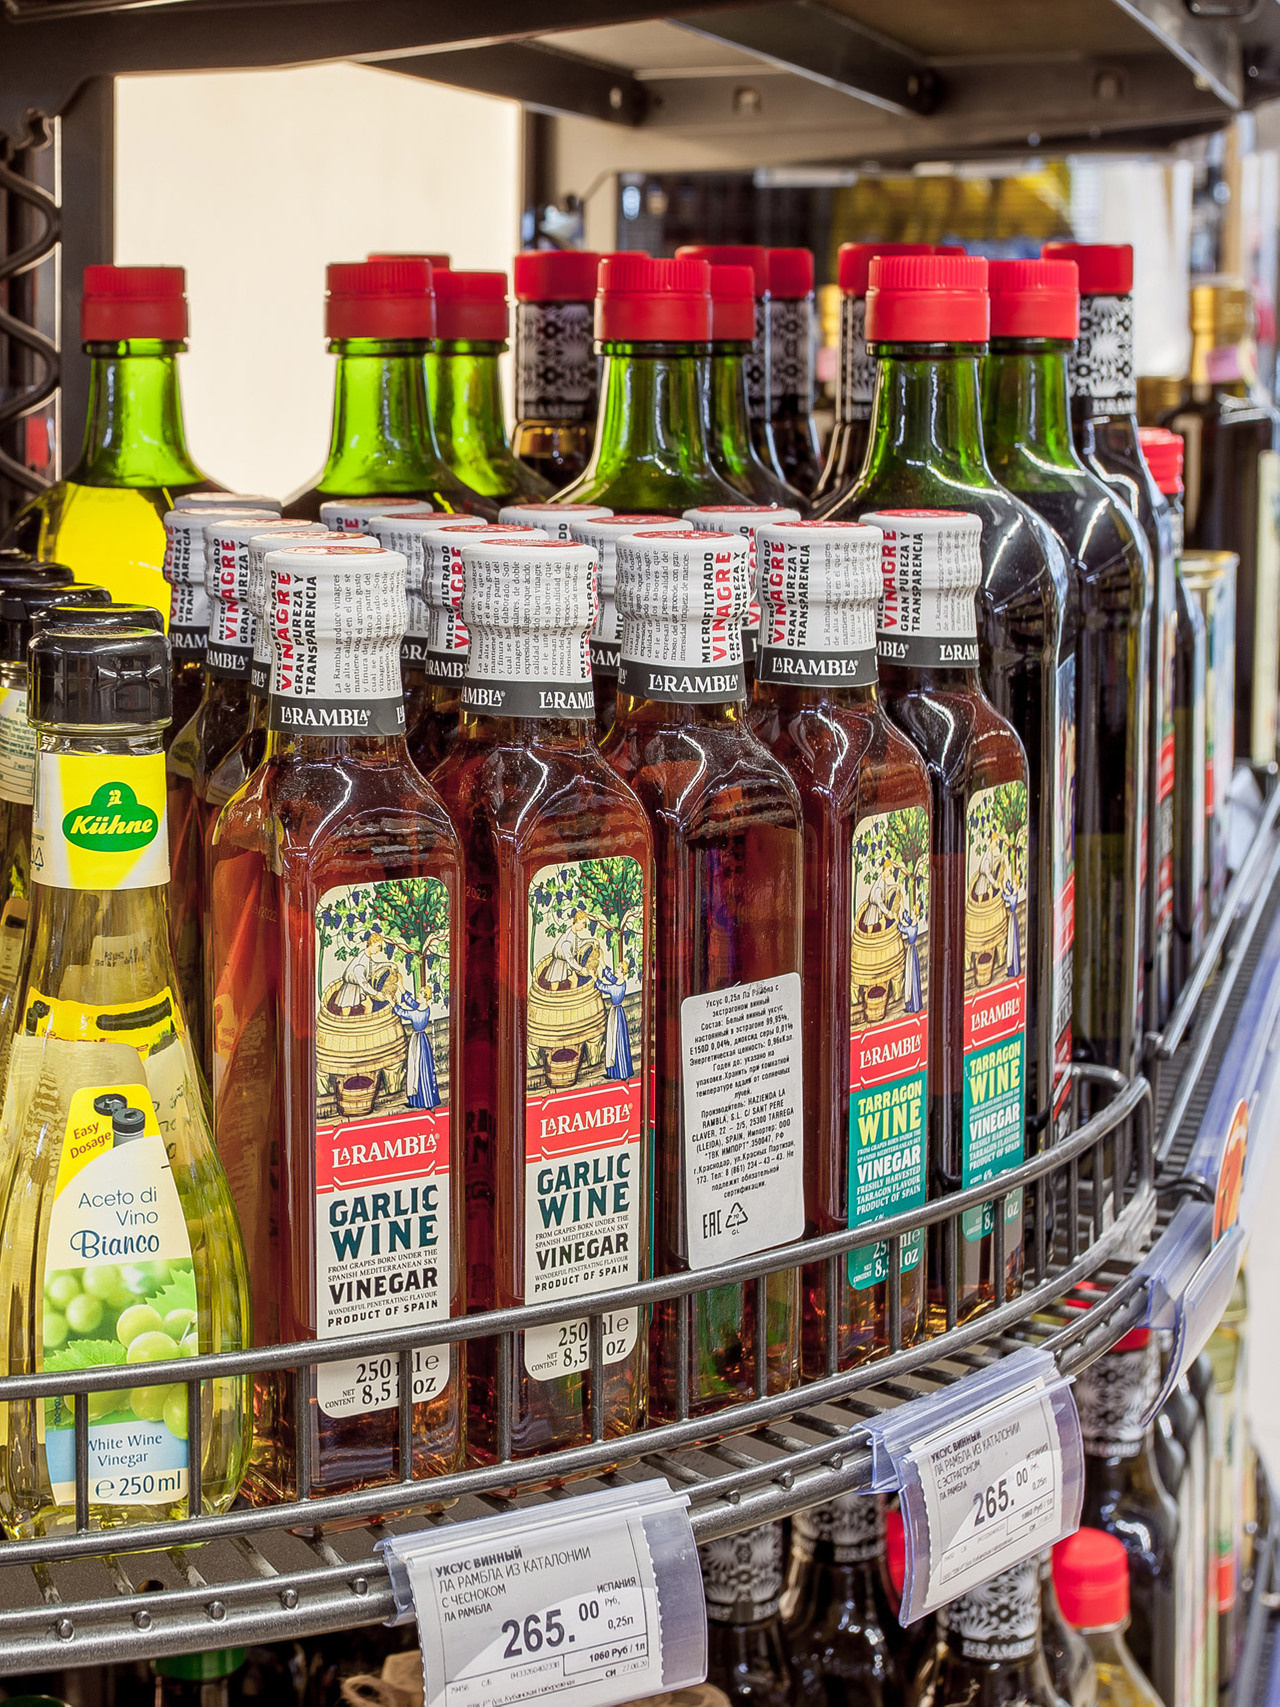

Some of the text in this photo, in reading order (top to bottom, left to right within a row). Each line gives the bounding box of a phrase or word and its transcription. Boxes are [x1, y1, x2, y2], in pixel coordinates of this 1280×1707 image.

[221, 539, 238, 640] VINAGRE
[333, 574, 342, 610] vinagres
[770, 541, 785, 644] VINAGRE
[881, 529, 897, 629] VINAGRE
[911, 533, 923, 632] TRANSPARENCIA
[702, 552, 714, 663] MICROFILTRADO
[713, 551, 731, 662] VINAGRE
[796, 544, 810, 647] TRANSPARENCIA
[276, 573, 294, 691] VINAGRE
[305, 576, 317, 695] TRANSPARENCIA
[69, 814, 153, 835] Kühne
[706, 999, 723, 1008] Уксус
[970, 1040, 1021, 1075] TARRAGON
[970, 1058, 1020, 1105] WINE
[858, 1080, 922, 1116] TARRAGON
[73, 1121, 100, 1140] Easy
[858, 1098, 921, 1147] WINE
[970, 1102, 1020, 1142] VINEGAR
[70, 1131, 112, 1159] Dosage
[537, 1152, 631, 1196] GARLIC
[857, 1144, 920, 1184] VINEGAR
[885, 1165, 921, 1185] HARVESTED
[78, 1187, 157, 1209] Aceto di
[329, 1184, 438, 1227] GARLIC
[538, 1181, 630, 1229] WINE
[856, 1195, 889, 1215] PRODUCT
[116, 1210, 159, 1226] Vino
[70, 1230, 160, 1259] Bianco
[330, 1214, 438, 1262] WINE
[536, 1232, 629, 1271] VINEGAR
[328, 1264, 348, 1274] FROM
[350, 1260, 376, 1269] GRAPES
[378, 1255, 396, 1265] BORN
[398, 1251, 422, 1261] UNDER
[328, 1257, 438, 1282] SPANISH MEDITERRANEAN SKY
[534, 1264, 629, 1293] PRODUCT SPAIN
[329, 1267, 438, 1305] VINEGAR
[328, 1300, 438, 1327] PRODUCT OF SPAIN
[356, 1359, 392, 1384] 250
[413, 1376, 436, 1395] oz
[127, 1434, 163, 1447] Wine
[931, 1431, 981, 1463] УКСУС ВИННЫЙ
[945, 1421, 1020, 1473] РАМБЛА ИЗ КАТАЛОНИИ
[98, 1452, 148, 1468] Vinegar
[942, 1460, 980, 1487] ЭСТРАГОНОМ
[119, 1471, 181, 1496] 250 ml
[947, 1481, 967, 1497] РАМБЛА
[973, 1468, 1028, 1526] 265. 00
[435, 1545, 522, 1578] УКСУС ВИННЫЙ
[440, 1546, 591, 1593] ЛА РАМБЛА ИЗ КАТАЛОНИИ
[442, 1583, 506, 1608] С ЧЕСНОКОМ
[597, 1576, 637, 1594] ИСПАНИЯ
[444, 1603, 492, 1622] ЛА РАМБЛА
[608, 1615, 634, 1630] 0,25л
[501, 1600, 599, 1660] 265. 00
[589, 1645, 629, 1663] 1060 Руб
[605, 1668, 616, 1678] СИ
